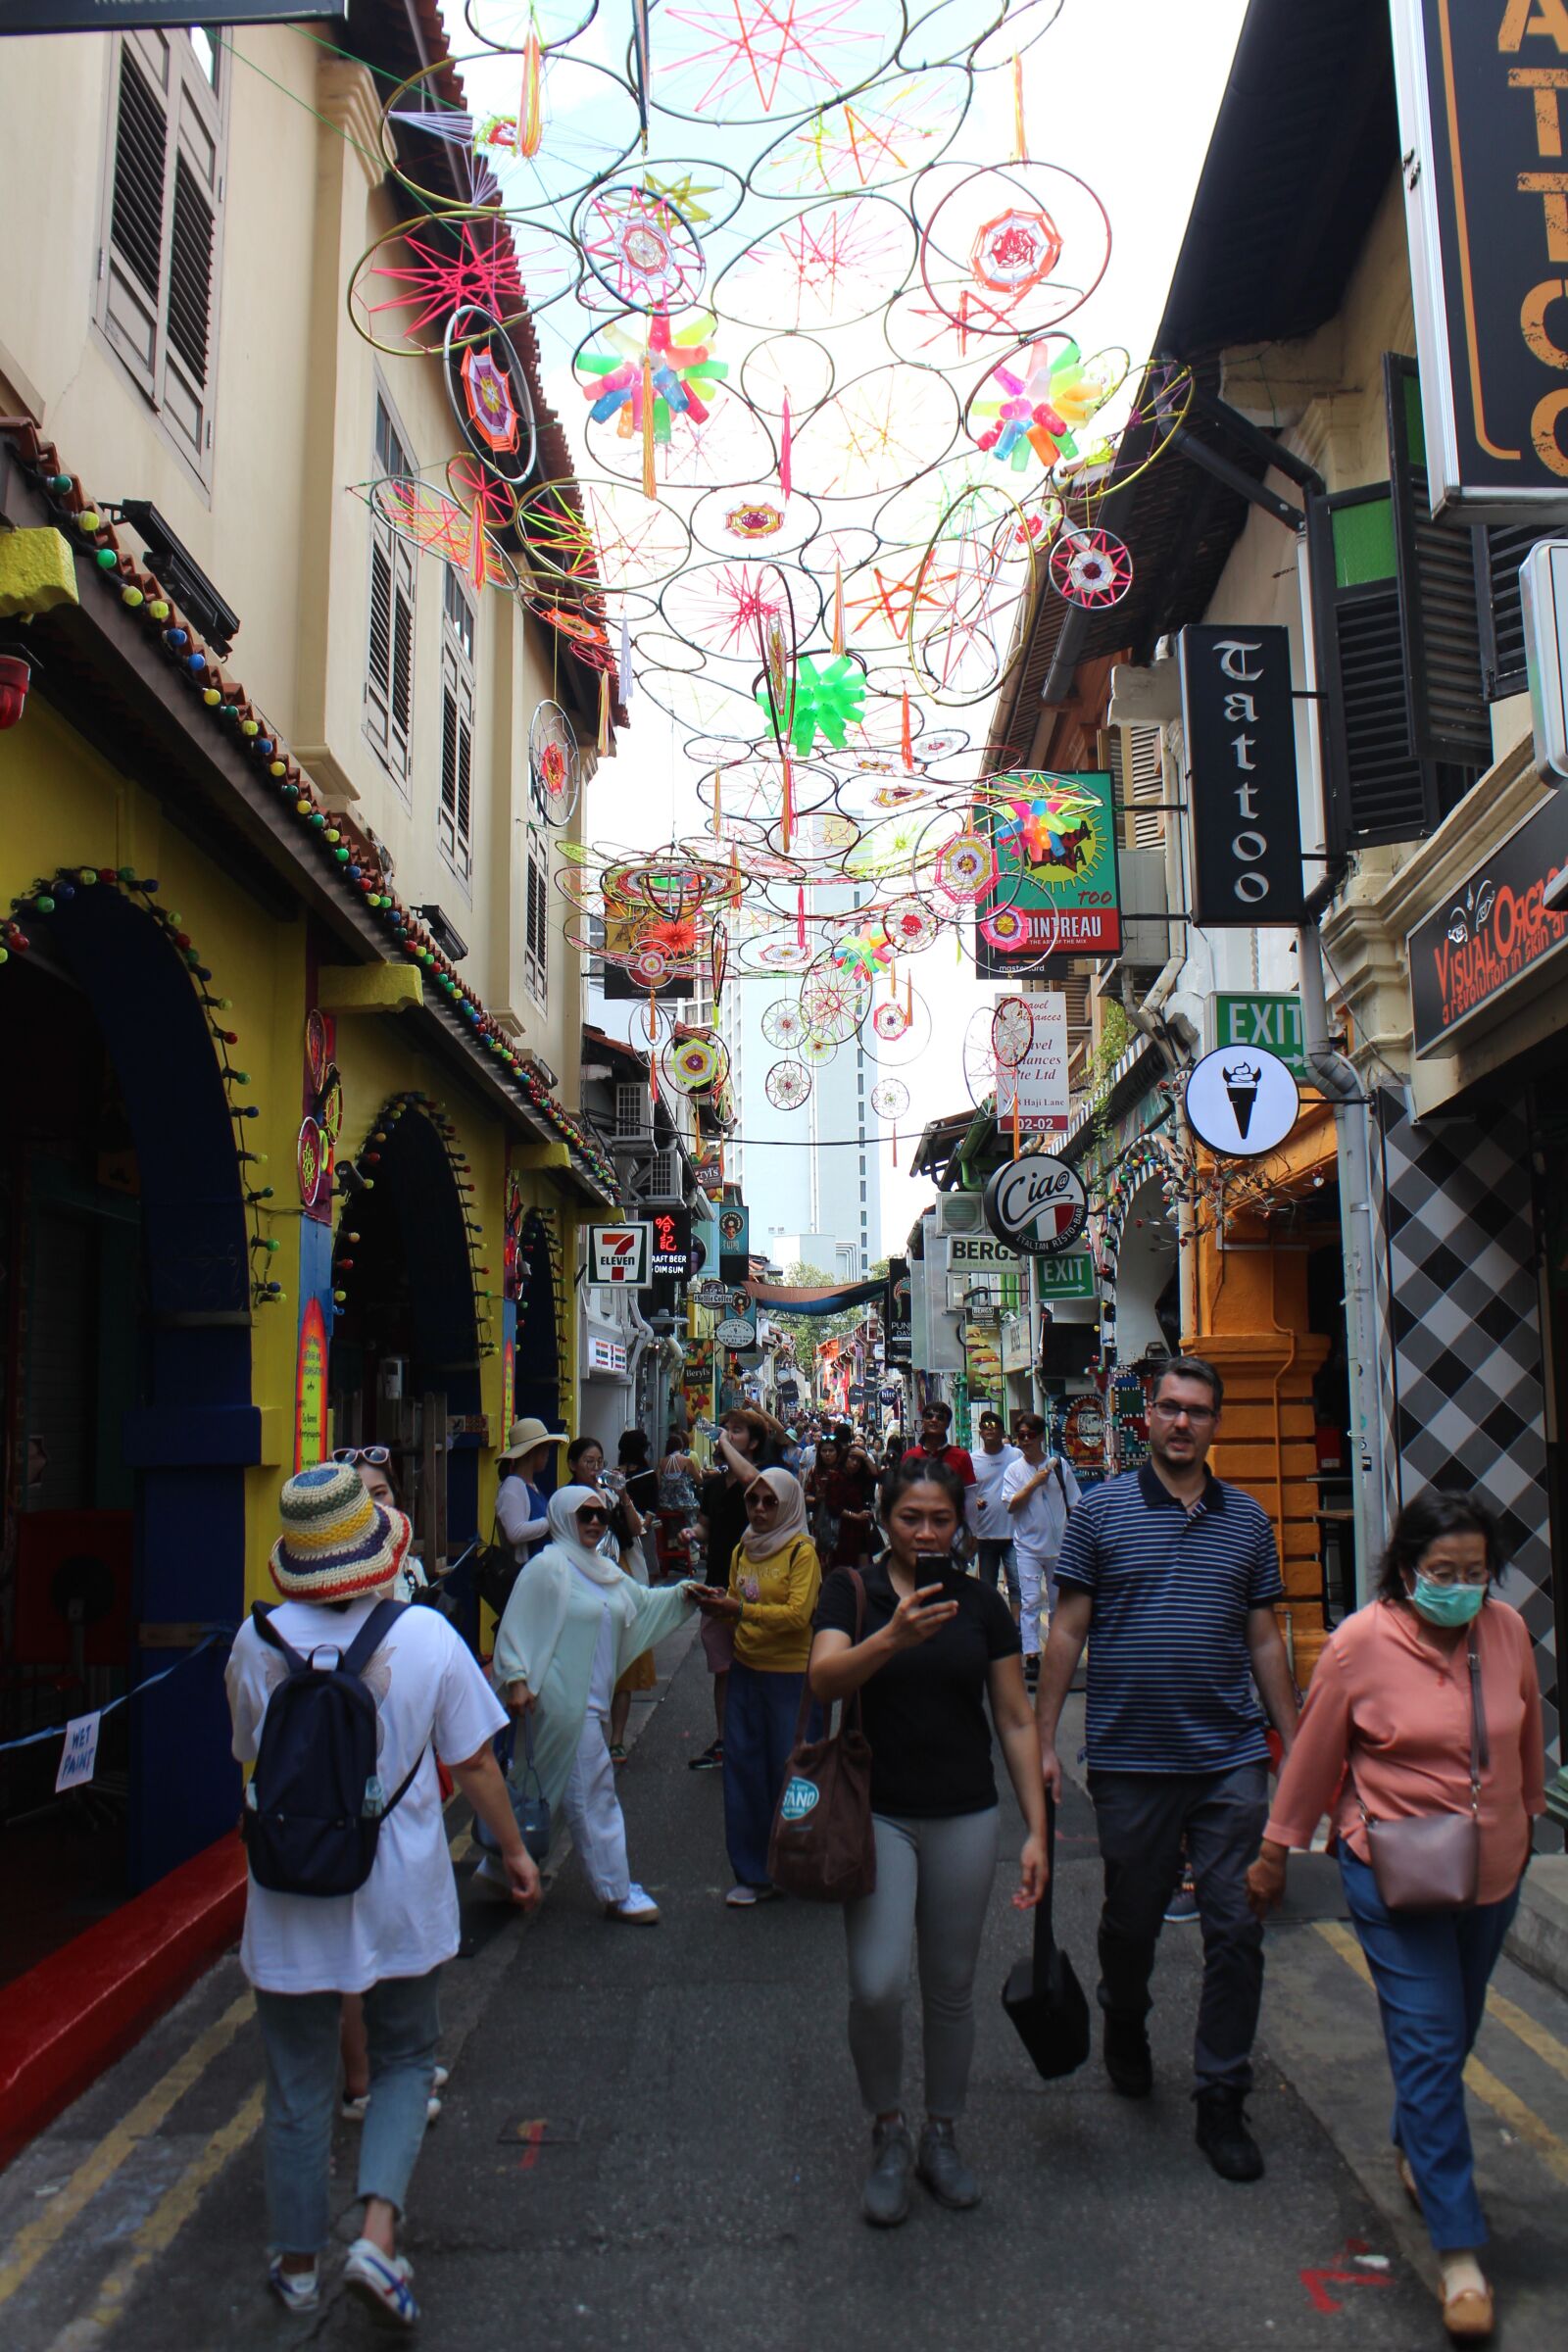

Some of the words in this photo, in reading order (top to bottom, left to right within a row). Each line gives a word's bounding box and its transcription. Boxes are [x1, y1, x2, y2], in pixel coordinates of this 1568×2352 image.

[1211, 639, 1269, 903] Tattoo
[1078, 890, 1113, 906] TOO
[1450, 957, 1508, 1020] revolution
[1511, 947, 1522, 974] in
[1525, 924, 1549, 963] skin
[1229, 1003, 1301, 1045] EXIT
[1035, 1068, 1056, 1080] Ltd
[1024, 1099, 1042, 1108] Haji
[1052, 1227, 1076, 1248] RISTO
[1073, 1206, 1086, 1225] BAR
[1043, 1258, 1085, 1283] EXIT
[72, 1725, 92, 1750] WET
